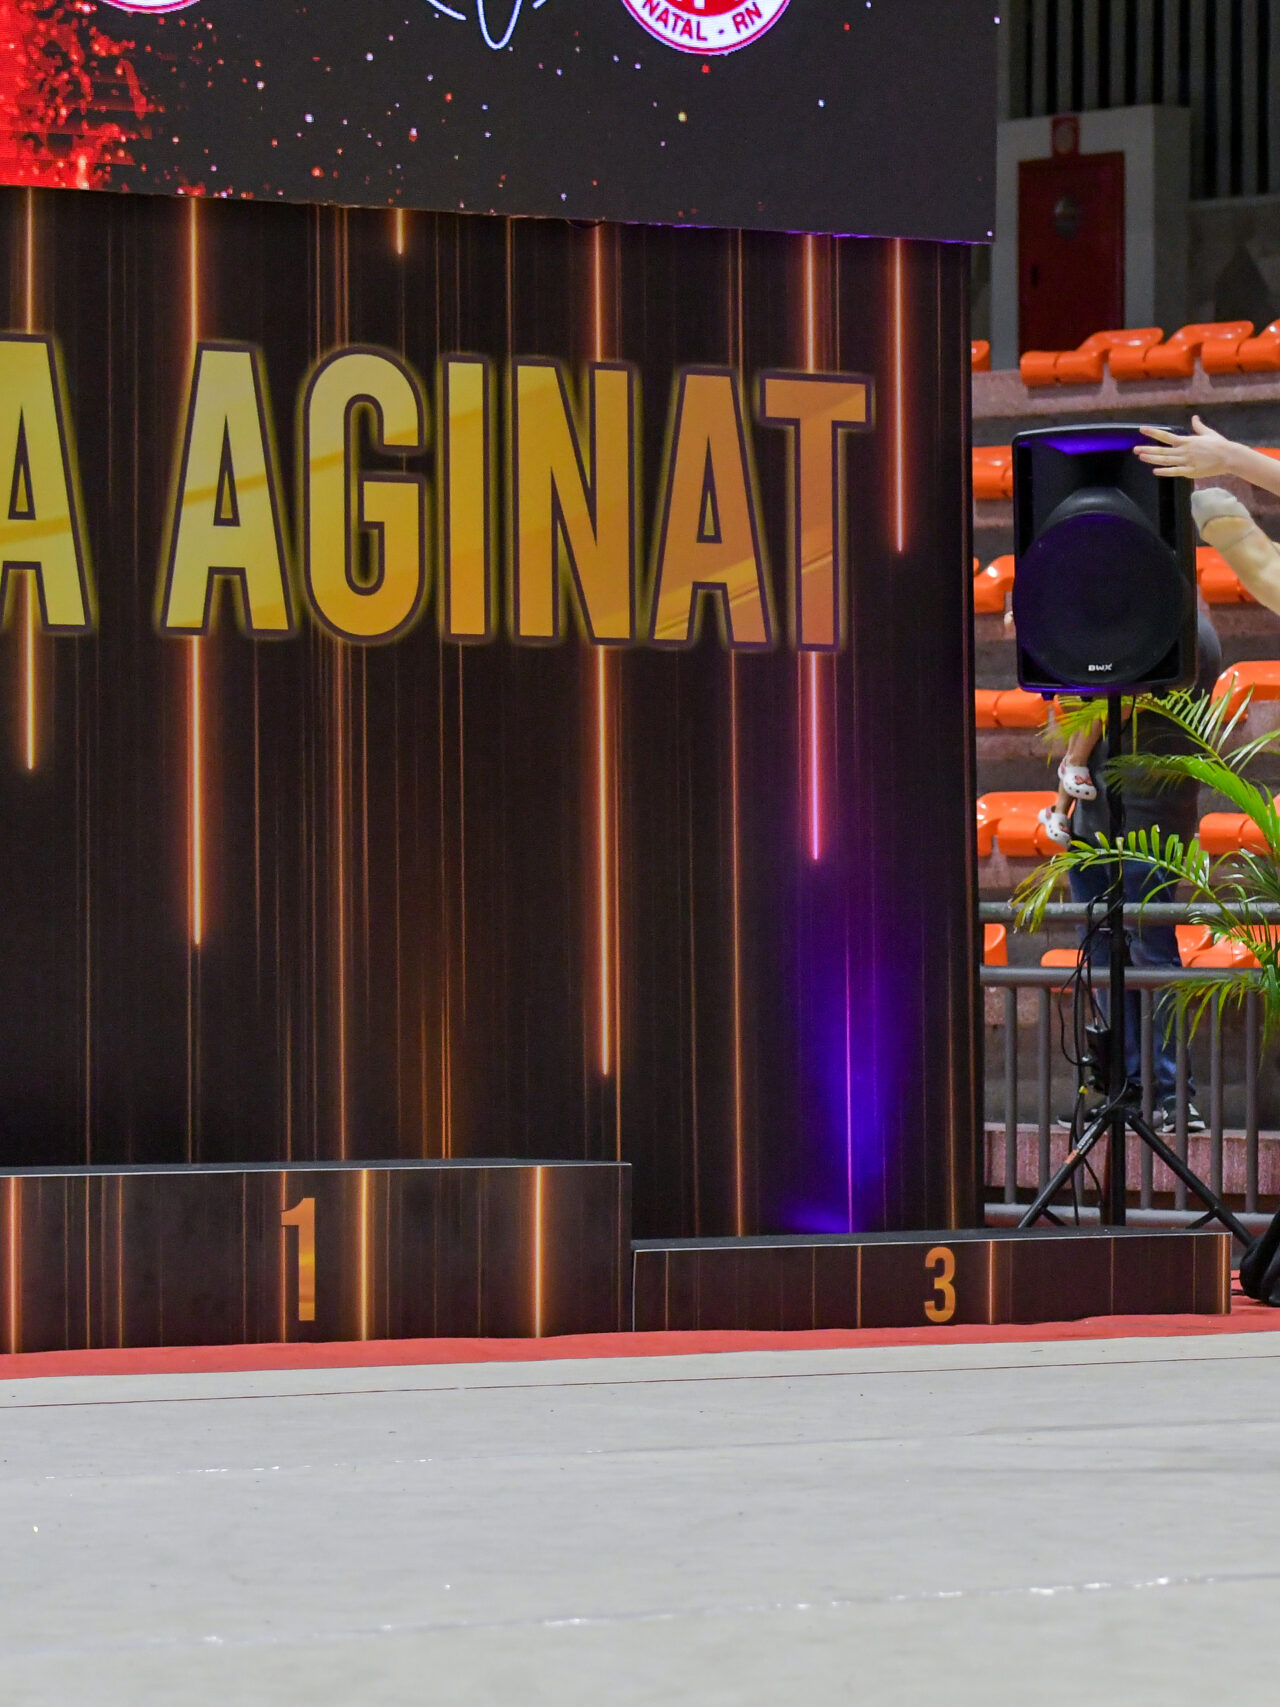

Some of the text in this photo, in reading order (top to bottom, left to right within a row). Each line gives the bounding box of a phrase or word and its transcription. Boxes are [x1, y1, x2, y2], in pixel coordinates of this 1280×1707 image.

[642, 0, 708, 41] NATAL
[732, 2, 762, 34] RN
[160, 342, 874, 653] AGINAT
[281, 1197, 315, 1321] 1
[924, 1246, 956, 1323] 3
